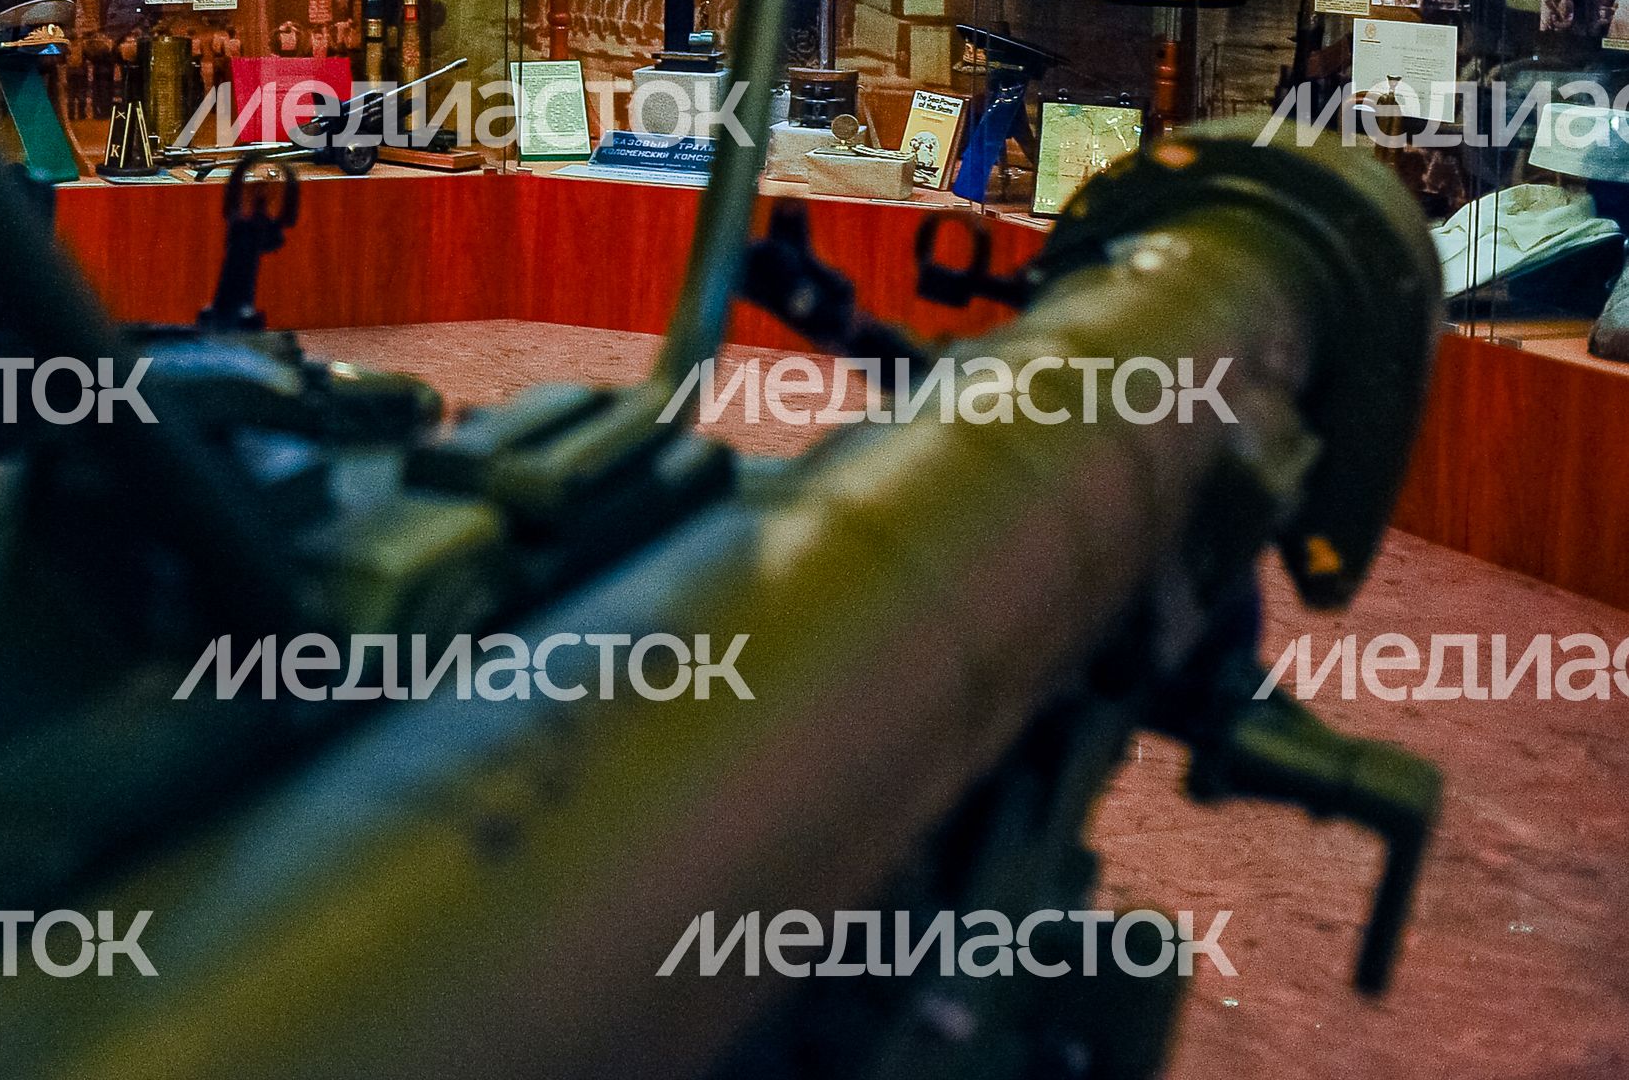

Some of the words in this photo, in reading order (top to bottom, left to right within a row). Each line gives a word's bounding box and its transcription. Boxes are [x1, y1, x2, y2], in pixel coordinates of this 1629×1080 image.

[916, 92, 928, 101] The
[940, 97, 961, 108] Power
[613, 136, 669, 149] БАЗОВЫЙ
[601, 147, 670, 159] КОЛОМЕНСКИЙ
